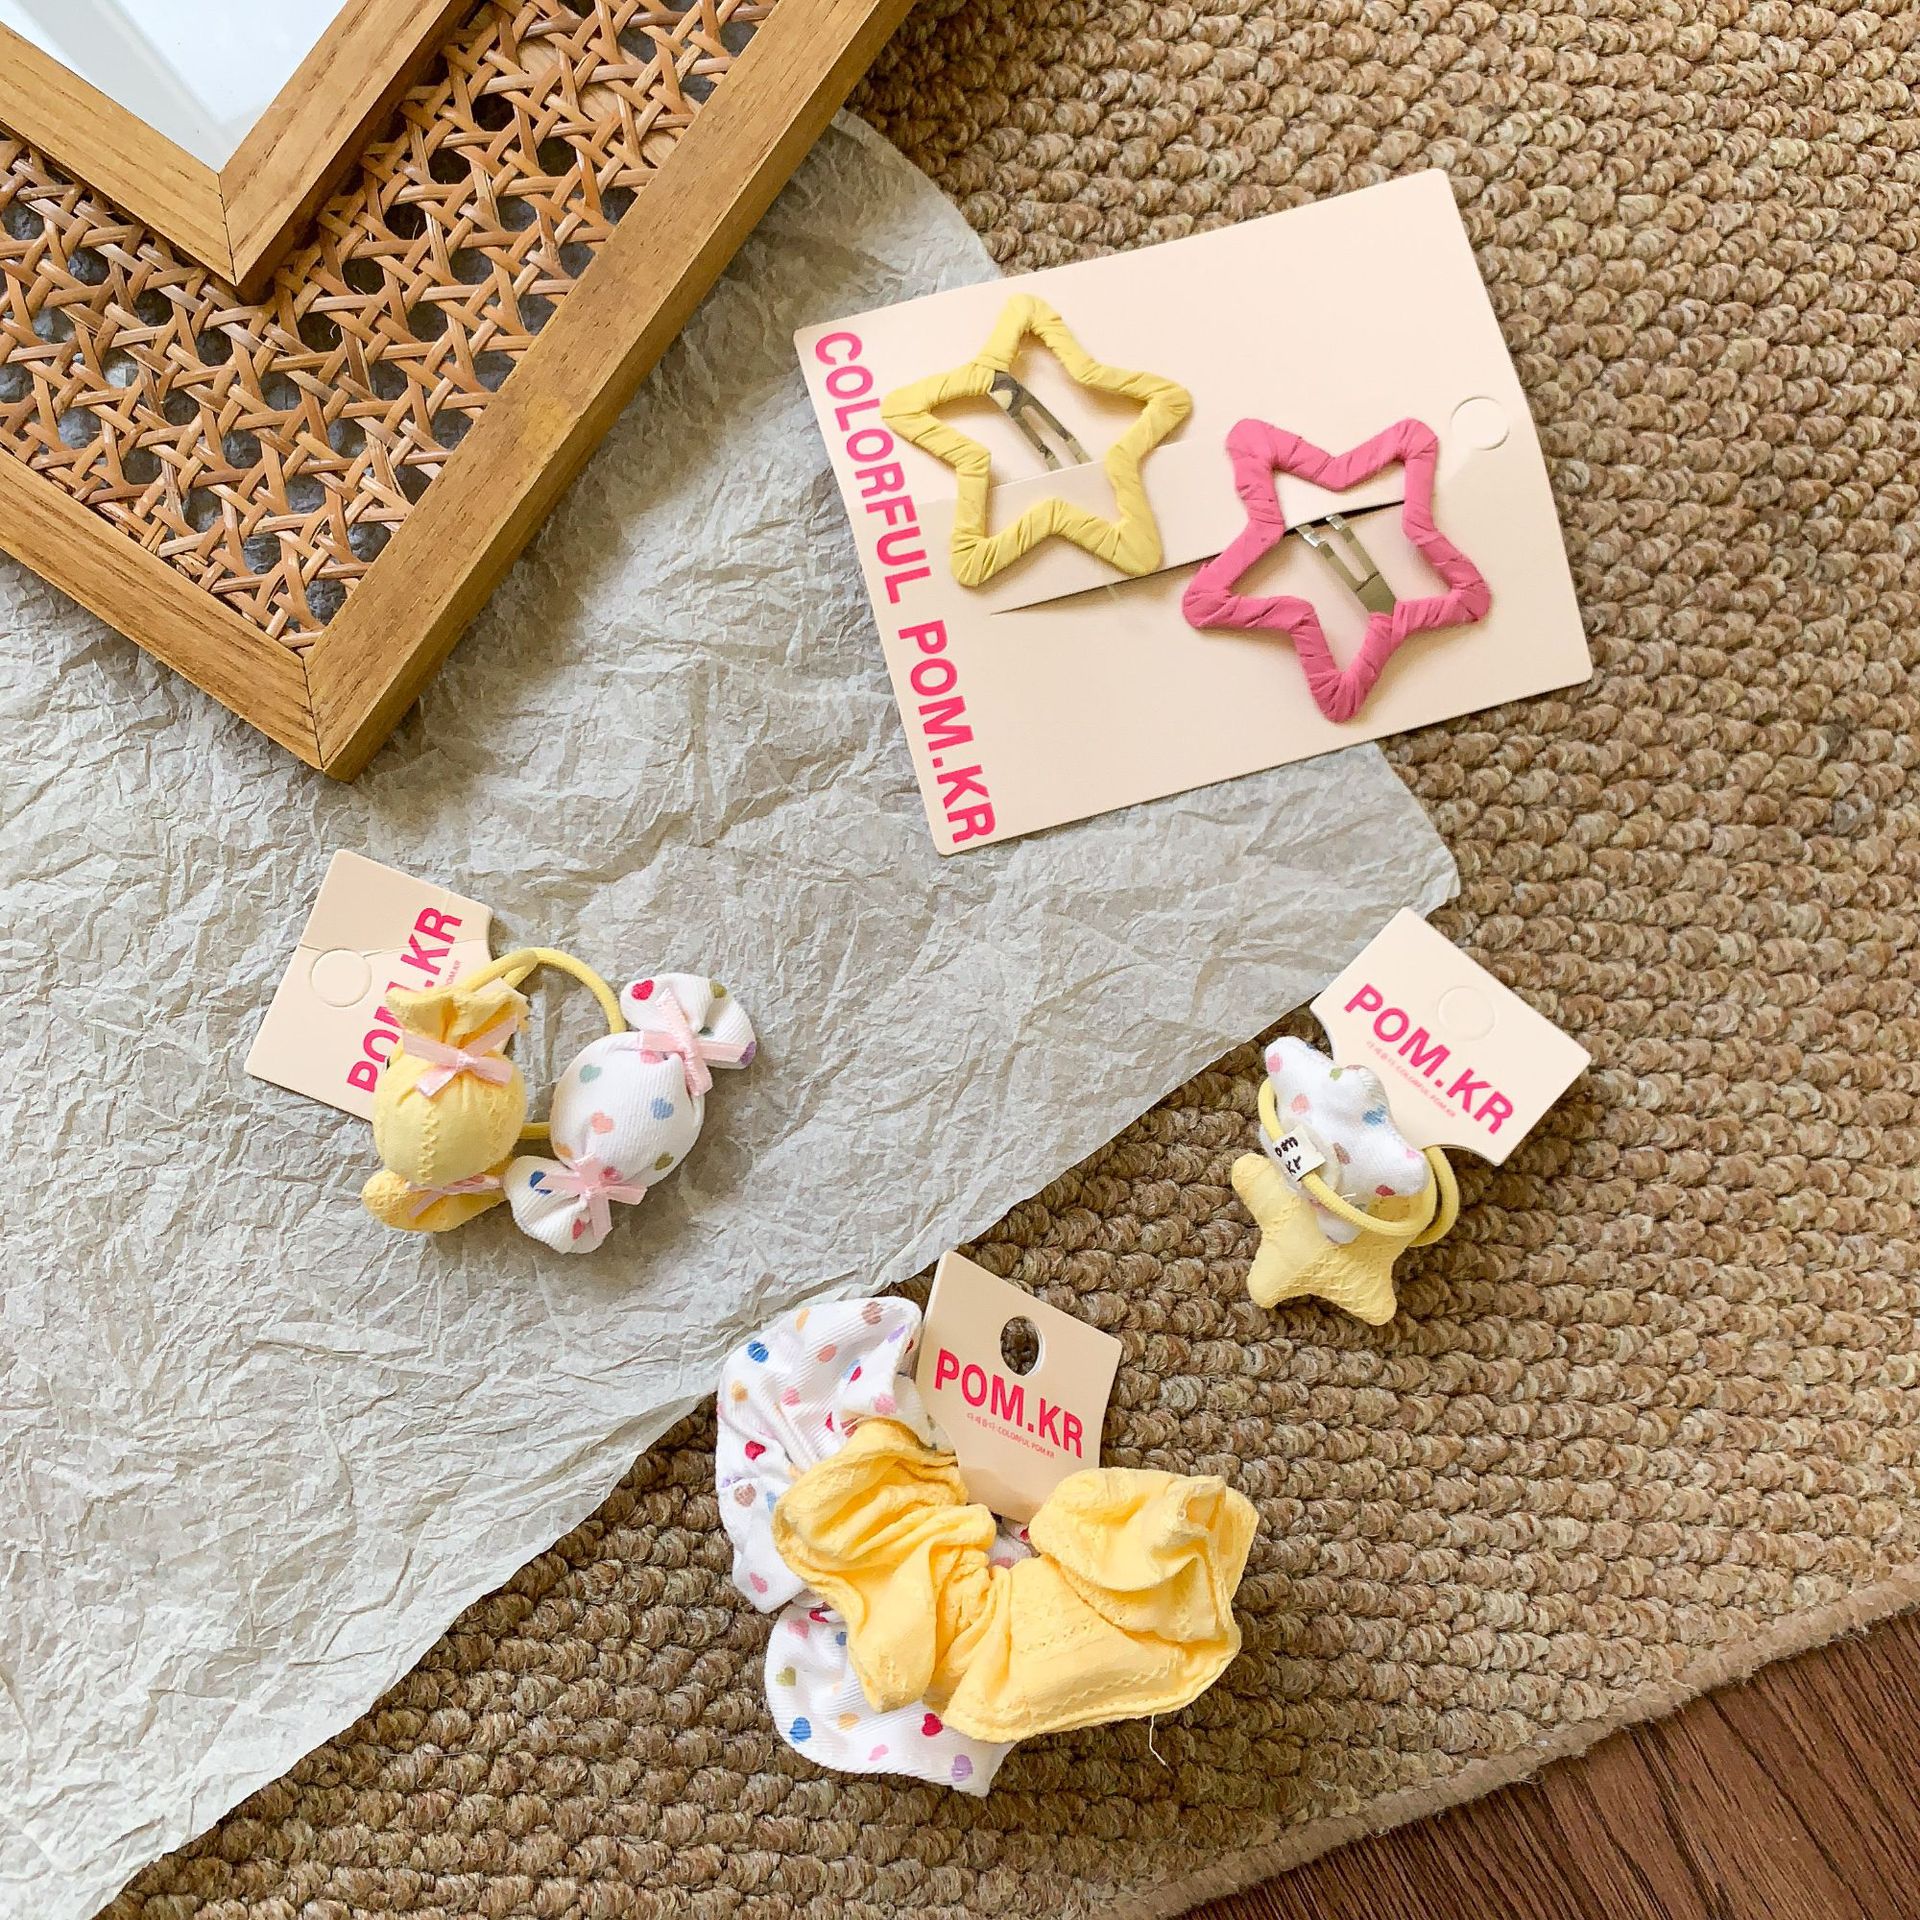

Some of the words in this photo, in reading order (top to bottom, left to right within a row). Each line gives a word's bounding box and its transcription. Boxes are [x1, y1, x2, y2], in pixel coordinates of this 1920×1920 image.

[815, 331, 931, 603] COLORFUL
[898, 620, 995, 843] POM.KR
[1344, 983, 1514, 1135] POM.KR
[935, 1348, 1083, 1459] POM.KR
